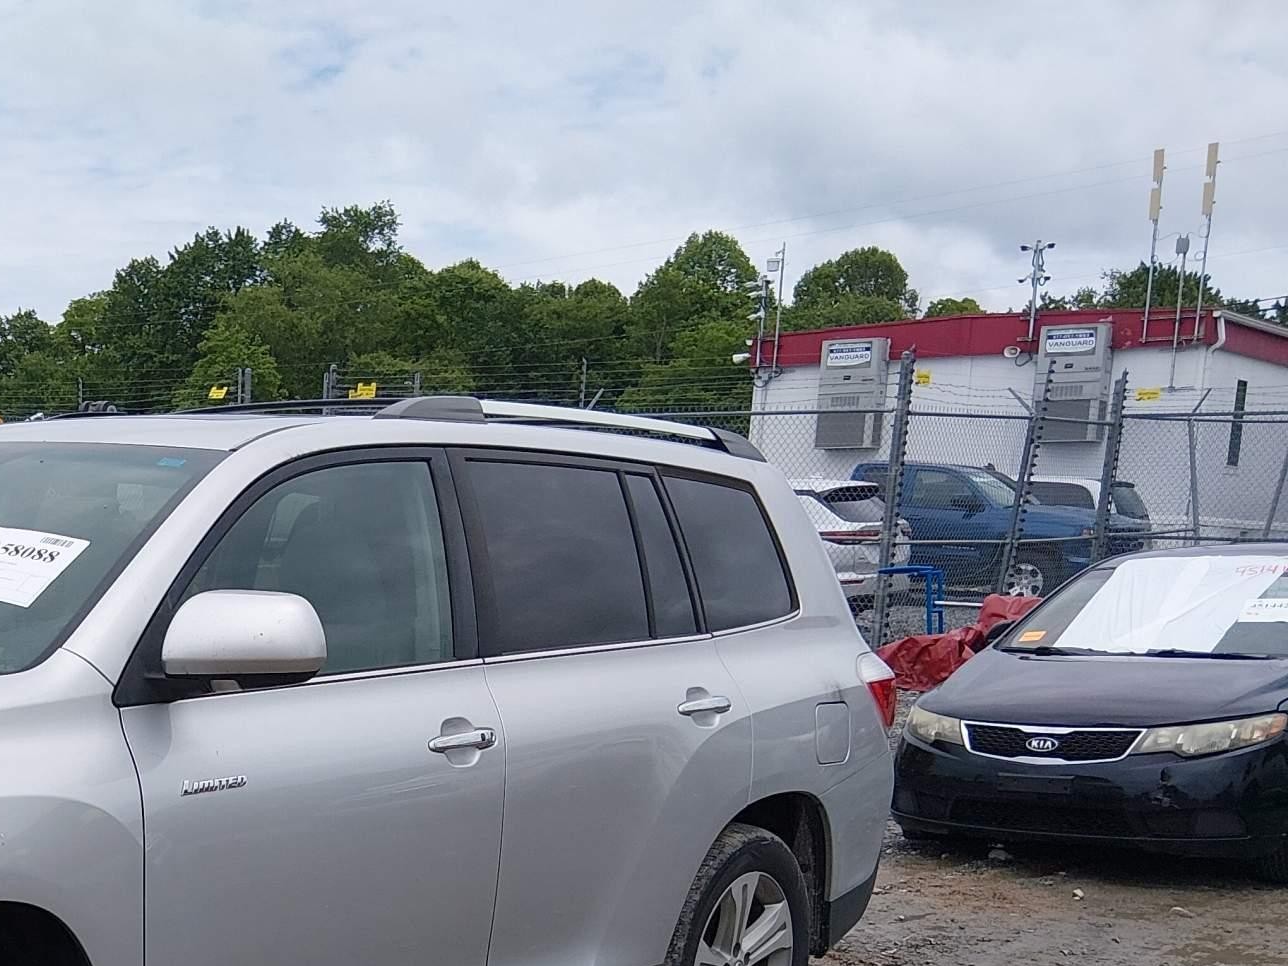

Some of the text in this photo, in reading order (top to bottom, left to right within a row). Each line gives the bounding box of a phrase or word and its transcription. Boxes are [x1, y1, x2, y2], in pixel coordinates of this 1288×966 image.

[1048, 340, 1094, 348] VANGUARD
[829, 352, 870, 361] VANGUARD
[1031, 739, 1052, 749] KIA
